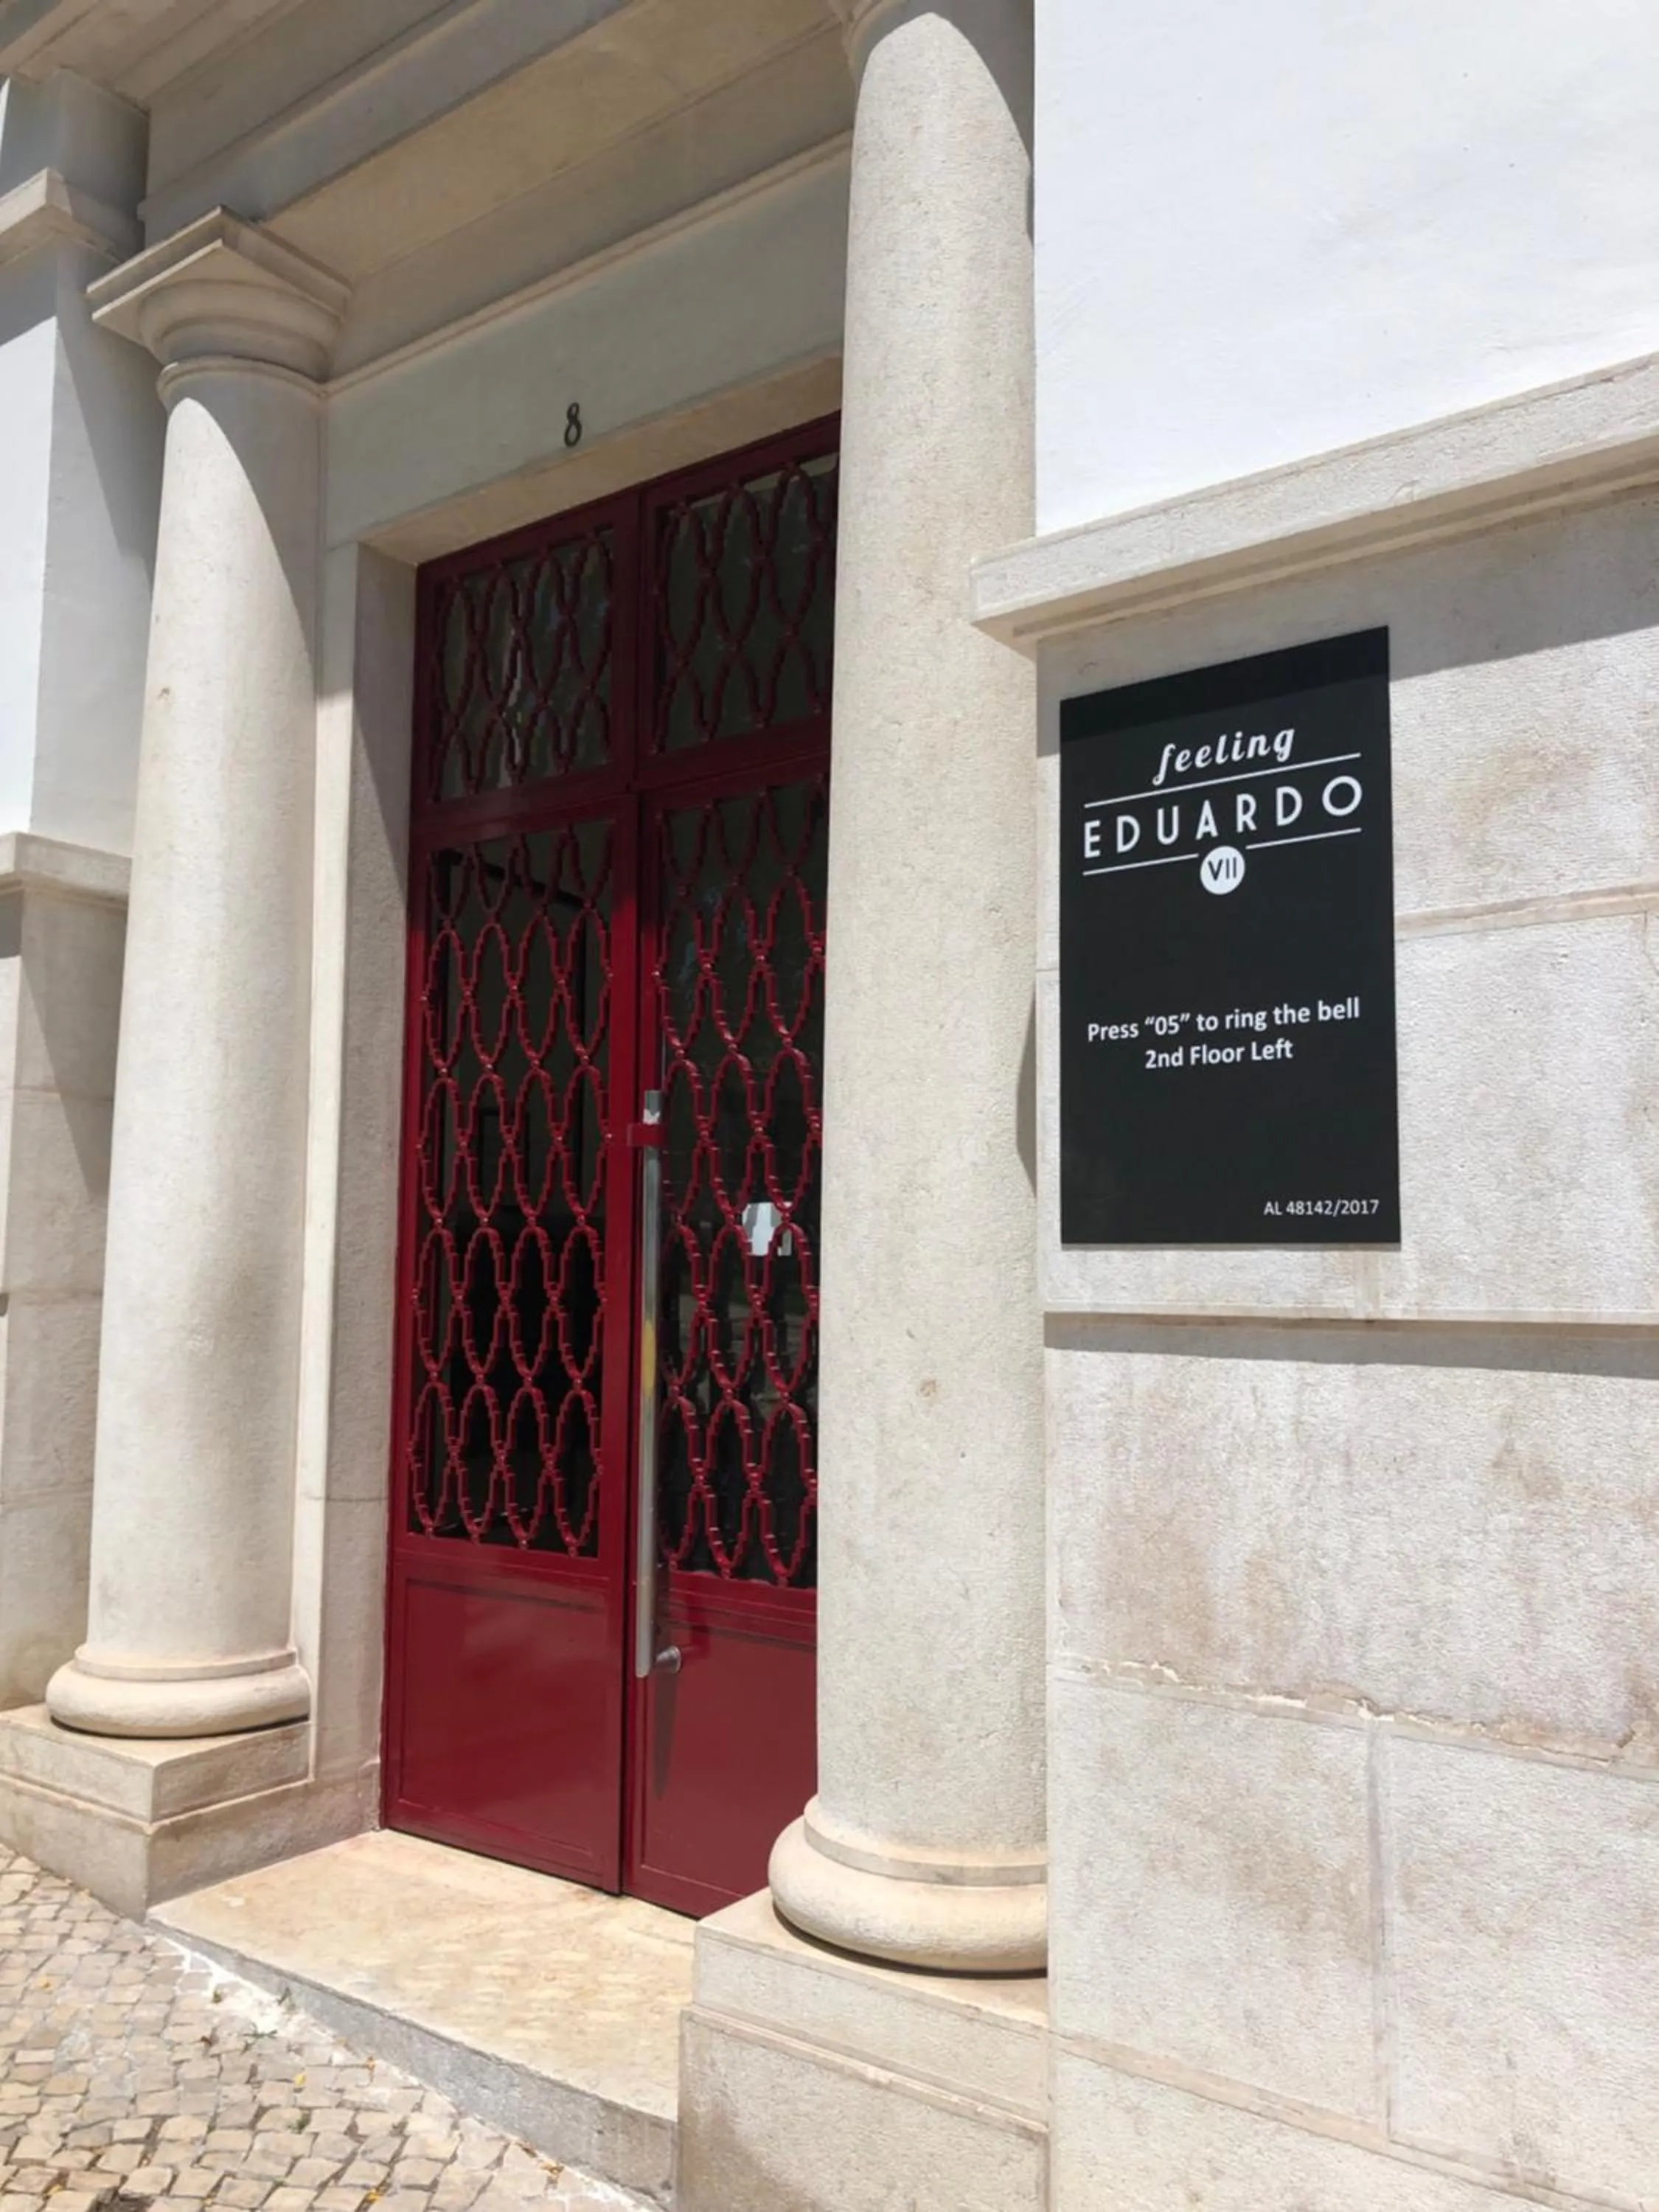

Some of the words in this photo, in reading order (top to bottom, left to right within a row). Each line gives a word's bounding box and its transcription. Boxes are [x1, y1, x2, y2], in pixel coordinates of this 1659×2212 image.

[564, 401, 582, 448] 8
[1152, 728, 1295, 787] feeling
[1083, 775, 1363, 858] EDUARDO
[1208, 857, 1237, 882] VII
[1088, 1023, 1139, 1042] Press
[1196, 1014, 1219, 1032] to
[1225, 1008, 1267, 1032] ring
[1273, 1004, 1311, 1026] the
[1318, 996, 1360, 1021] bell
[1145, 1046, 1183, 1069] 2nd
[1190, 1043, 1245, 1065] Floor
[1251, 1037, 1293, 1061] Left
[1264, 1201, 1282, 1216] AL
[1285, 1199, 1380, 1217] 48142/2017
